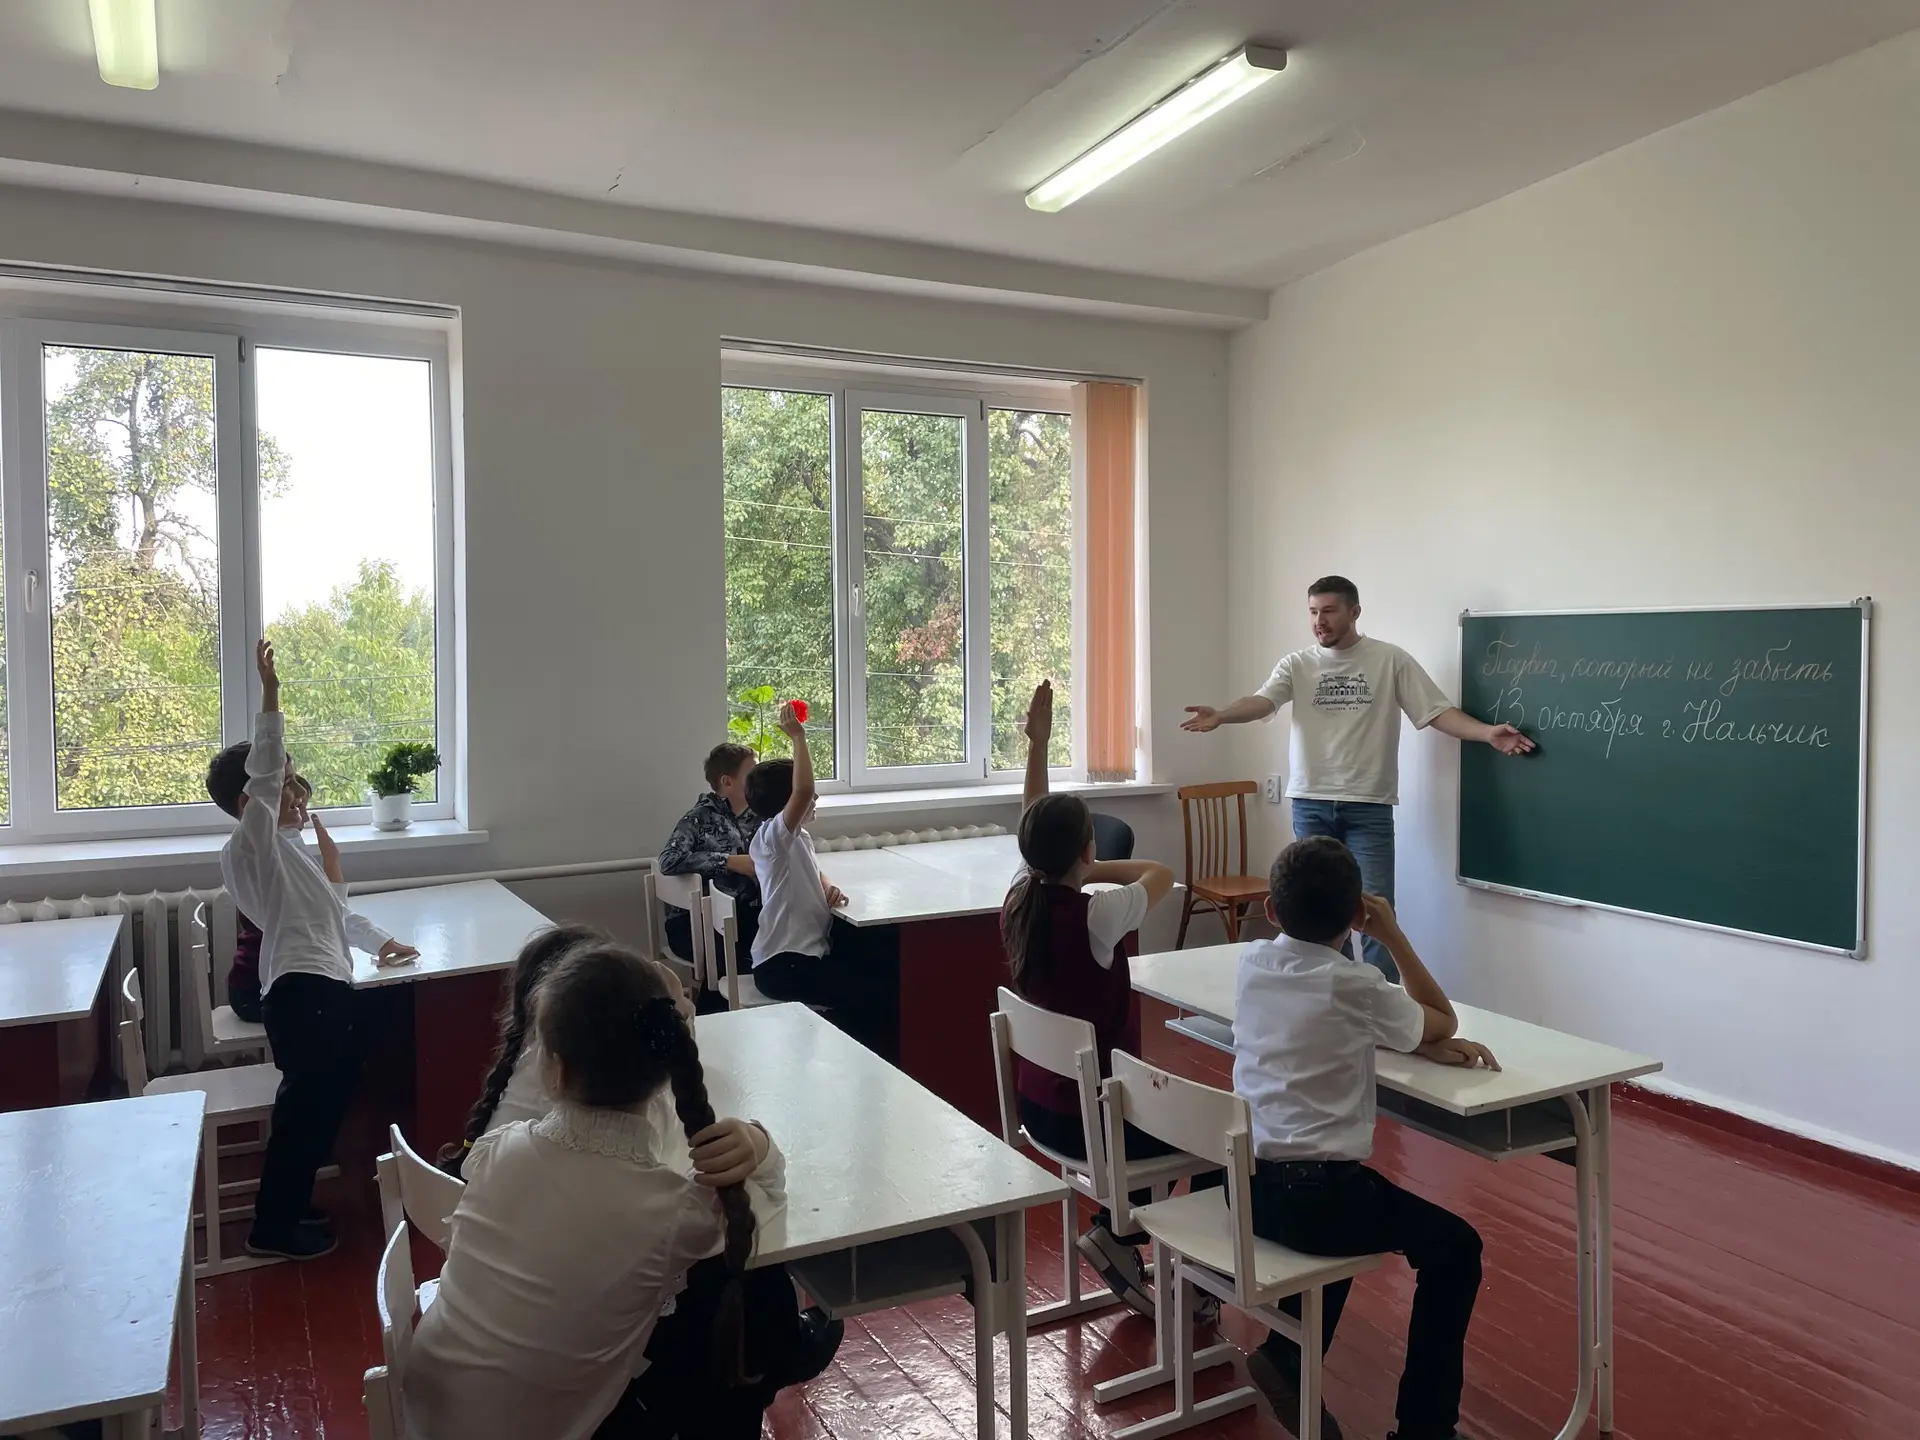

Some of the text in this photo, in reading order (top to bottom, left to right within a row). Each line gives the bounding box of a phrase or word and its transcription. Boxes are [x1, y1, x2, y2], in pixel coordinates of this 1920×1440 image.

[1482, 628, 1834, 697] Подвиг, который не забыть
[1486, 687, 1525, 730] 13
[1682, 698, 1831, 748] Нальчик
